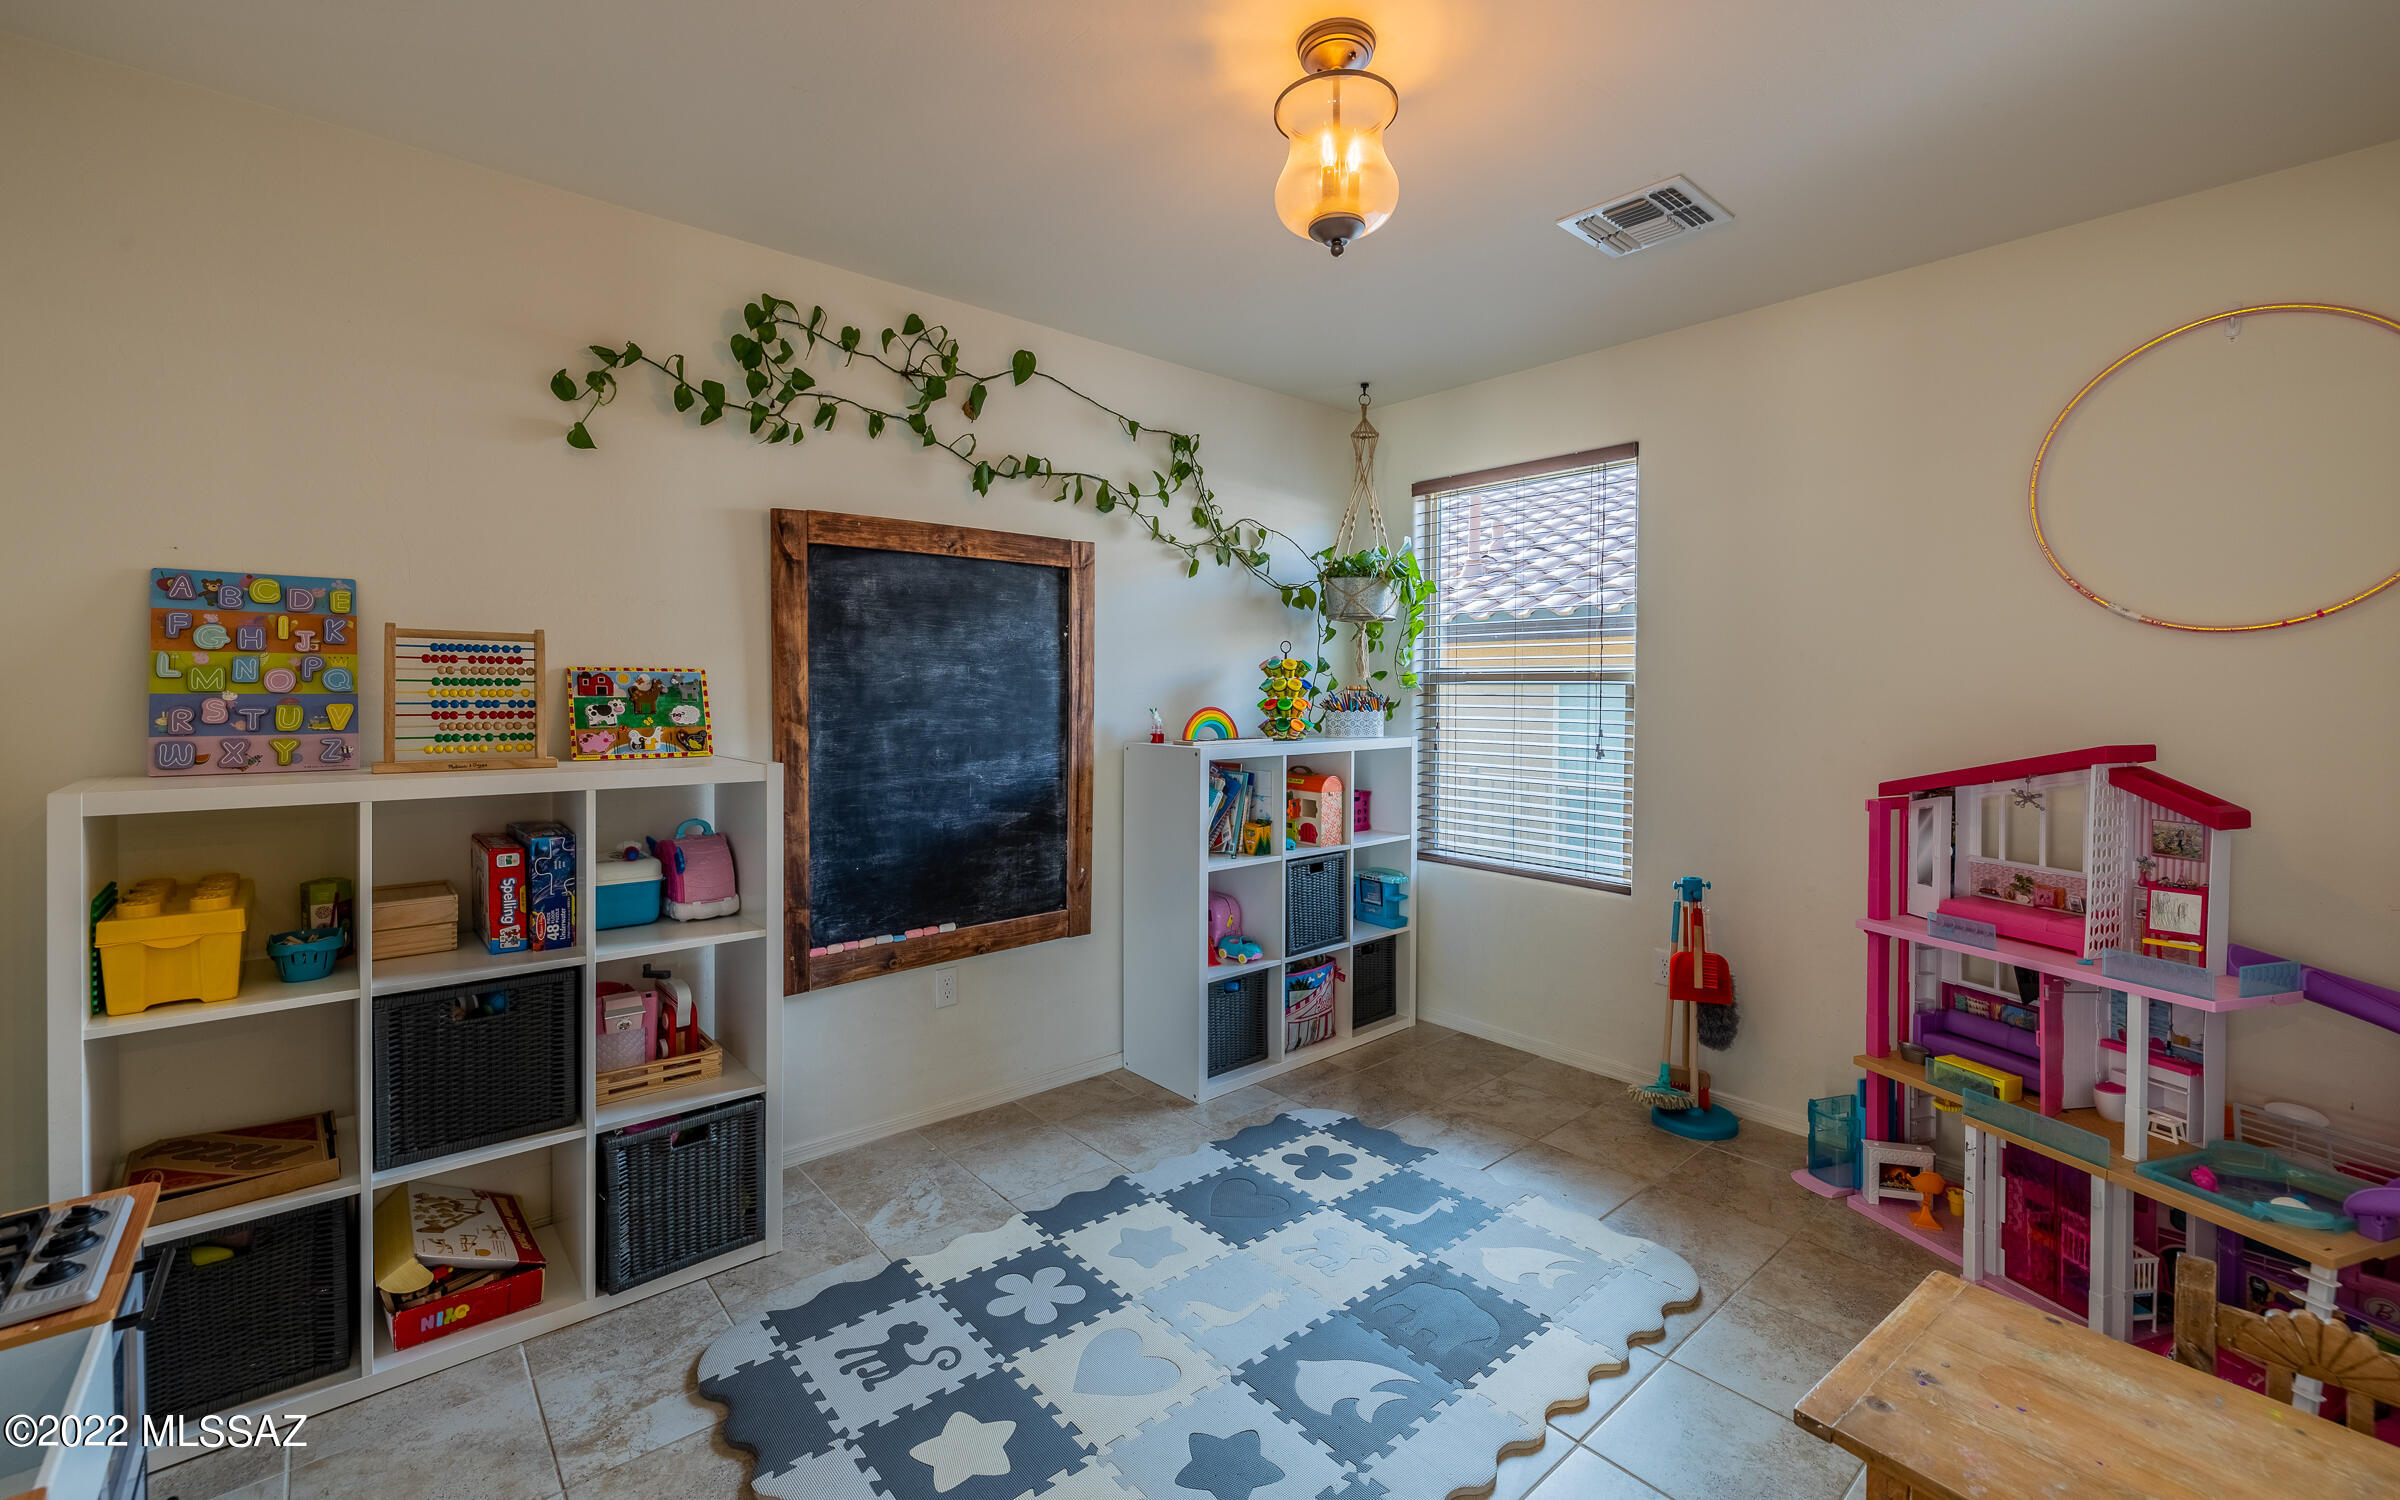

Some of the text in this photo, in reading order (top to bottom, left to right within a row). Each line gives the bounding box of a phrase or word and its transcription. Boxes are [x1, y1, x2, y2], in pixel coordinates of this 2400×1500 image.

[169, 575, 351, 613] A B C D E
[167, 612, 347, 652] F G H I J K
[157, 652, 353, 692] L M N O P Q
[171, 699, 353, 734] R S T U V
[157, 738, 343, 767] W X Y Z
[500, 877, 518, 924] Spelling
[547, 924, 560, 940] 48
